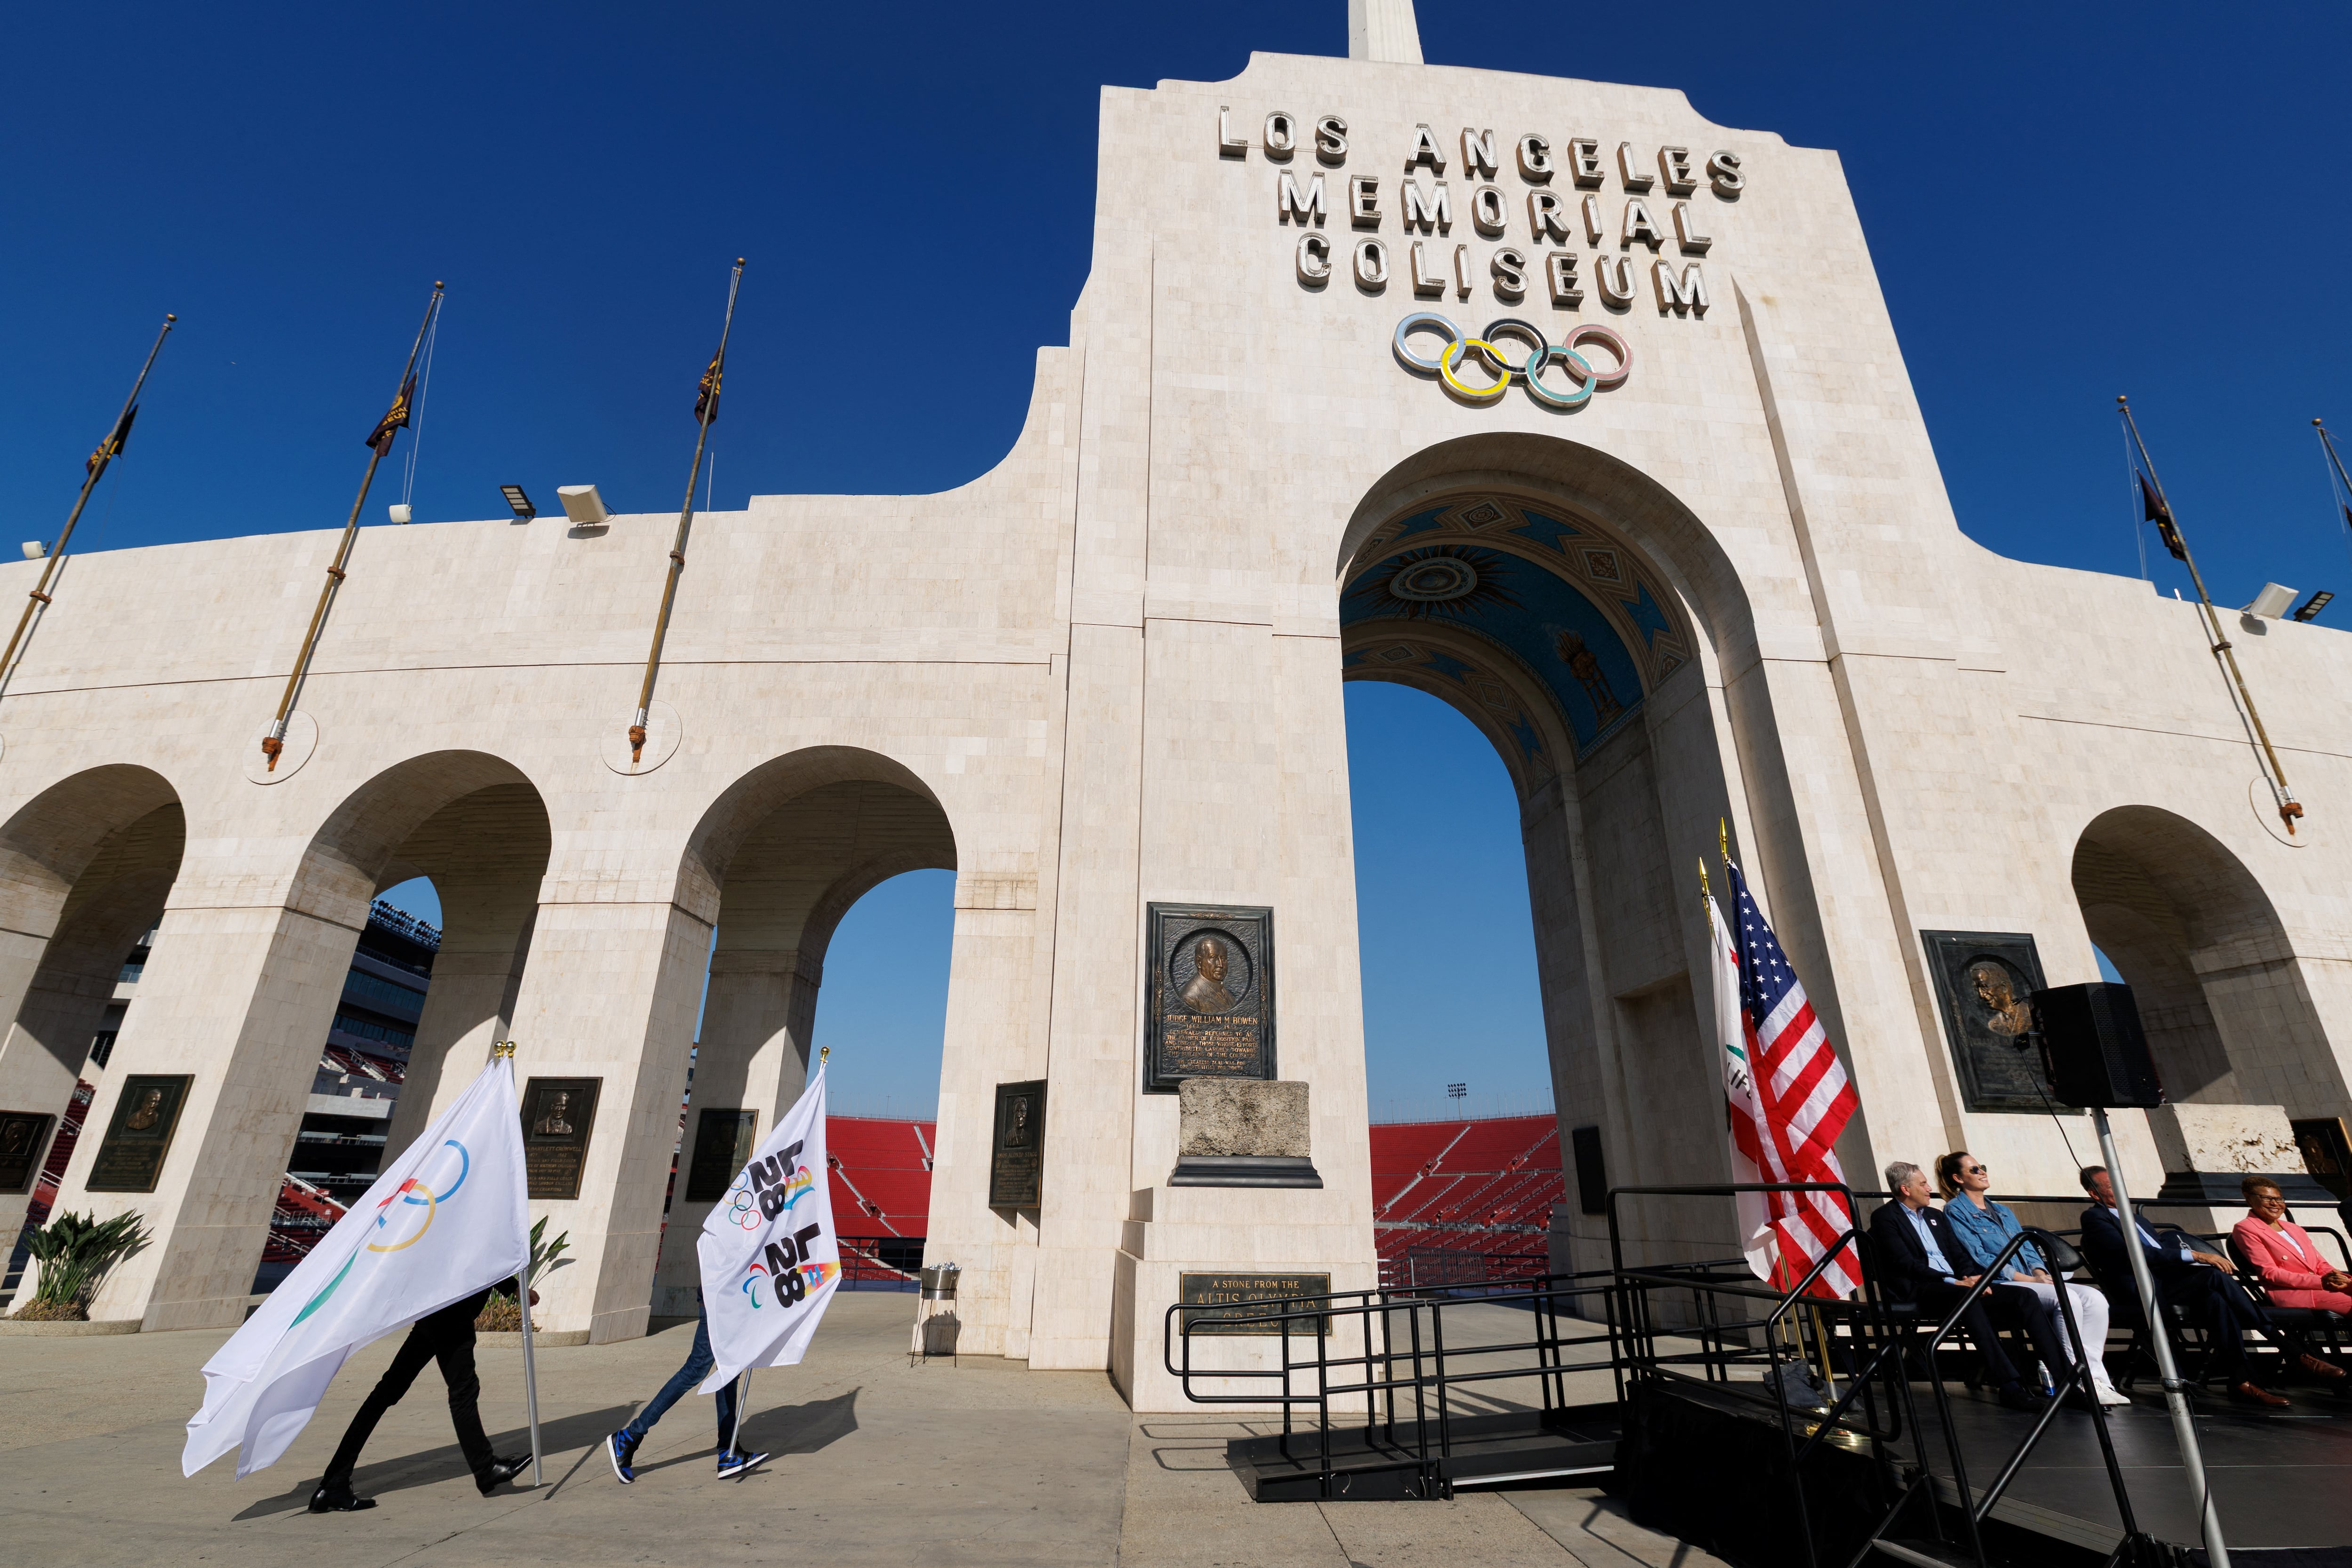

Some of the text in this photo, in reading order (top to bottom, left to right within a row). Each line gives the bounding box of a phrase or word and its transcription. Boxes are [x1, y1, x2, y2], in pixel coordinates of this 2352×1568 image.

[1219, 105, 1747, 199] LOS ANGELES
[1278, 169, 1712, 255] MEMORIAL
[1295, 231, 1710, 316] COLISEUM
[1166, 1015, 1188, 1023] JUDGE
[1191, 1015, 1222, 1024] WILLIAM
[1233, 1017, 1258, 1025] BOWEN
[764, 1237, 805, 1308] 28
[1255, 1281, 1278, 1289] FROM
